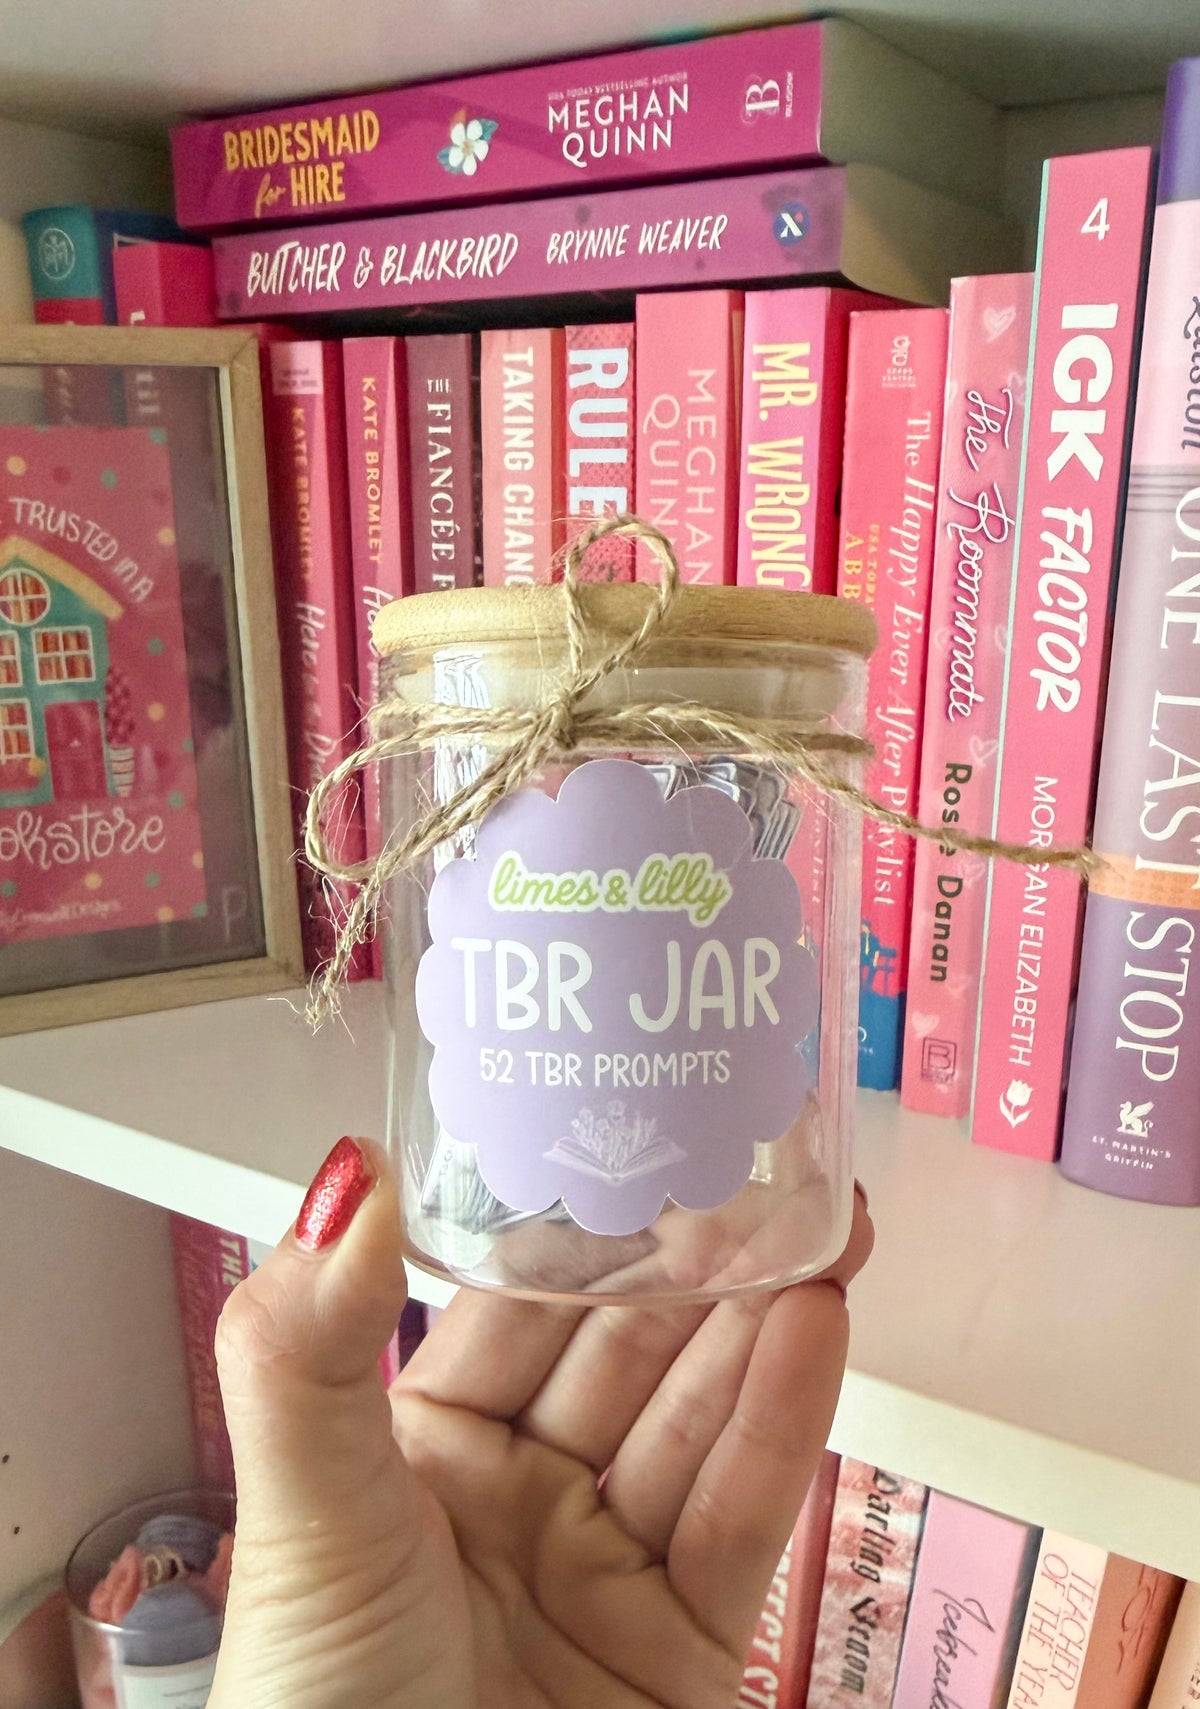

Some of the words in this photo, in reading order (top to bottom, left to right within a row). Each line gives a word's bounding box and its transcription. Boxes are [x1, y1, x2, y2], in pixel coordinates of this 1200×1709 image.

[223, 109, 380, 172] BRIDESMAID
[548, 83, 689, 133] MEGHAN
[562, 119, 672, 168] QUINN
[254, 172, 286, 219] for
[290, 161, 346, 207] HIRE
[1080, 197, 1110, 241] 4
[247, 240, 346, 298] BUTCHER
[353, 247, 373, 286] &
[380, 232, 519, 284] BLACKBIRD
[546, 223, 630, 266] BRYNNE
[637, 213, 728, 255] WEAVER
[362, 377, 377, 440] KATE
[502, 346, 535, 471] TAKING
[752, 342, 818, 422] MR.
[1047, 302, 1119, 483] ICK
[291, 407, 309, 467] KATE
[568, 347, 629, 516] RULE
[904, 411, 931, 467] The
[965, 389, 1012, 471] The
[365, 451, 383, 564] BROMLEY
[427, 402, 461, 562] FIANCÉE
[642, 393, 681, 563] QUIN
[686, 369, 717, 586] MEGHAN
[745, 436, 812, 589] WRONG
[8, 497, 119, 562] TRUSTED
[868, 523, 880, 552] USA
[887, 476, 936, 597] Happy
[865, 559, 878, 612] TODA
[946, 483, 1014, 722] Roommate
[1029, 506, 1094, 713] FACTOR
[887, 602, 924, 684] Ever
[875, 685, 915, 783] After
[938, 762, 973, 857] Rose
[1133, 690, 1200, 890] LAST
[493, 856, 597, 907] limes
[604, 879, 627, 904] &
[638, 858, 729, 921] lilly
[930, 875, 964, 983] Danan
[451, 938, 593, 1033] TBR
[628, 939, 781, 1033] JAR
[1009, 925, 1045, 1066] ELIZABETH
[1115, 910, 1196, 1083] STOP
[480, 1048, 514, 1084] 52
[525, 1051, 583, 1087] TBR
[594, 1050, 731, 1088] PROMPTS
[850, 1466, 901, 1583] Darling
[1042, 1552, 1070, 1599] OF
[1026, 1602, 1056, 1650] THE
[1049, 1567, 1099, 1691] TEACHER
